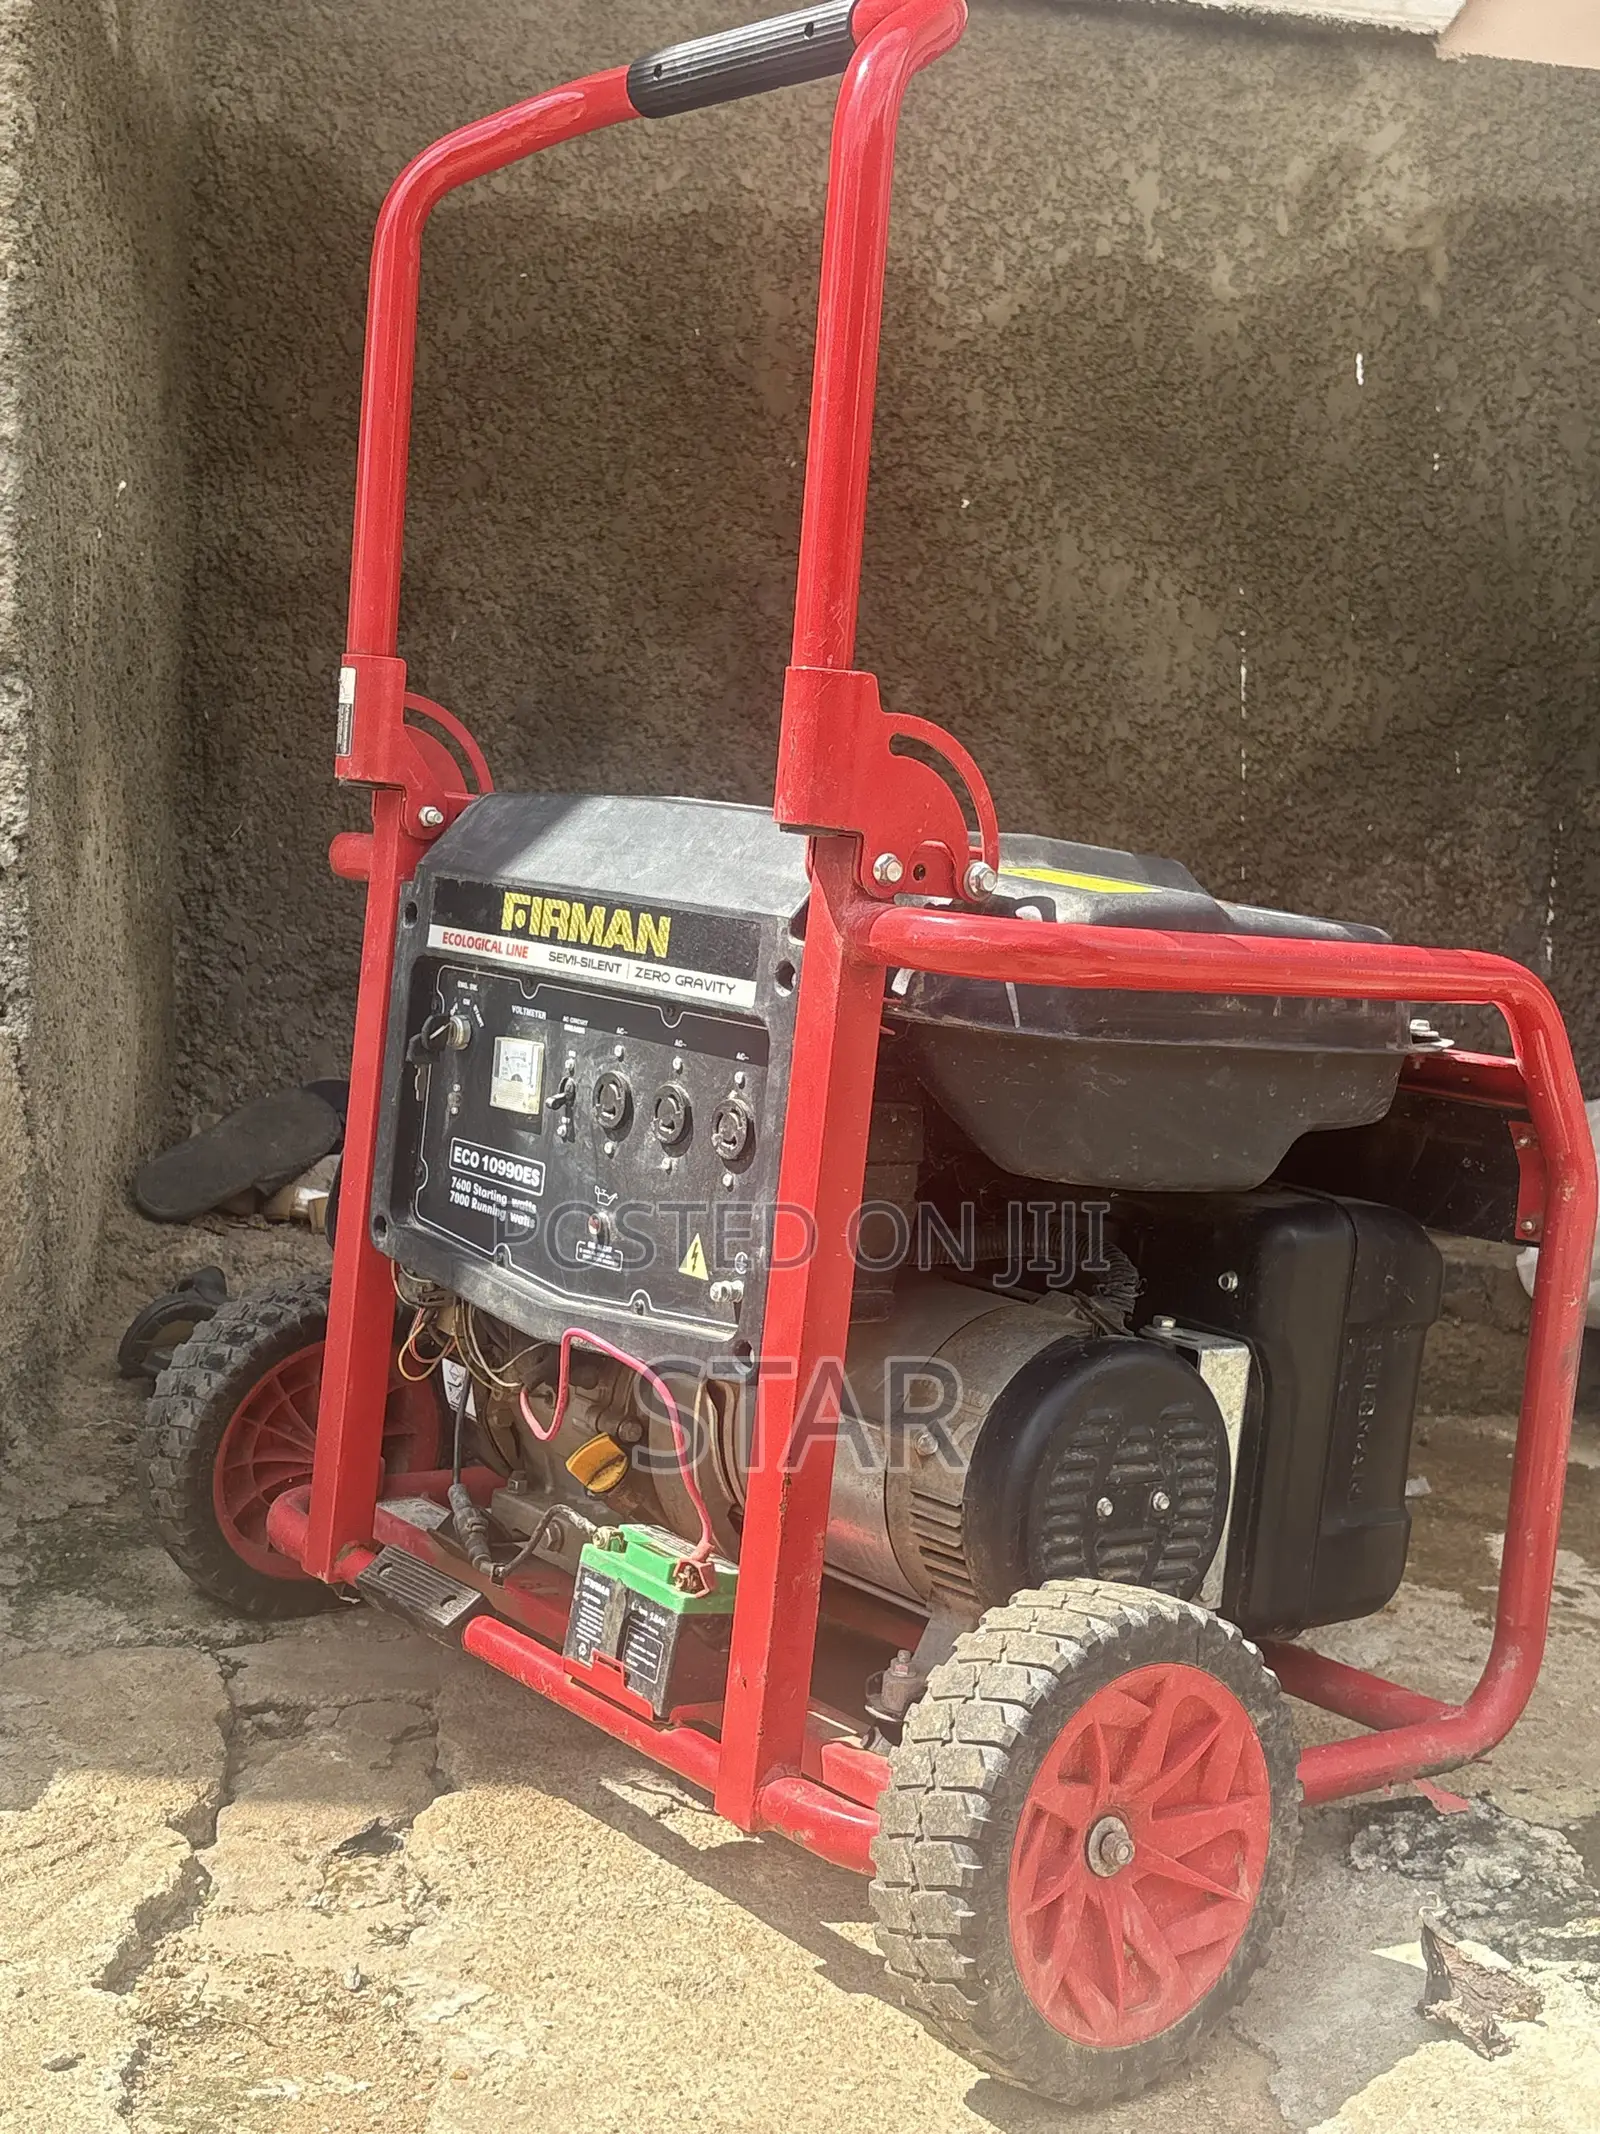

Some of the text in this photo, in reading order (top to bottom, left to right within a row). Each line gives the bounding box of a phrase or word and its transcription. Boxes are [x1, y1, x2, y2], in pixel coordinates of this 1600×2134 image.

[501, 891, 672, 958] FIRMAN
[442, 931, 736, 995] ECOLOGICAL LINE SEMI-SILENT ZERO GRAVITY
[511, 1004, 547, 1021] VOLTMETER
[453, 1146, 541, 1187] ECO 10990ES
[449, 1190, 470, 1208] 7000
[471, 1197, 507, 1222] Running
[451, 1176, 472, 1193] 7600
[472, 1183, 508, 1207] Starting
